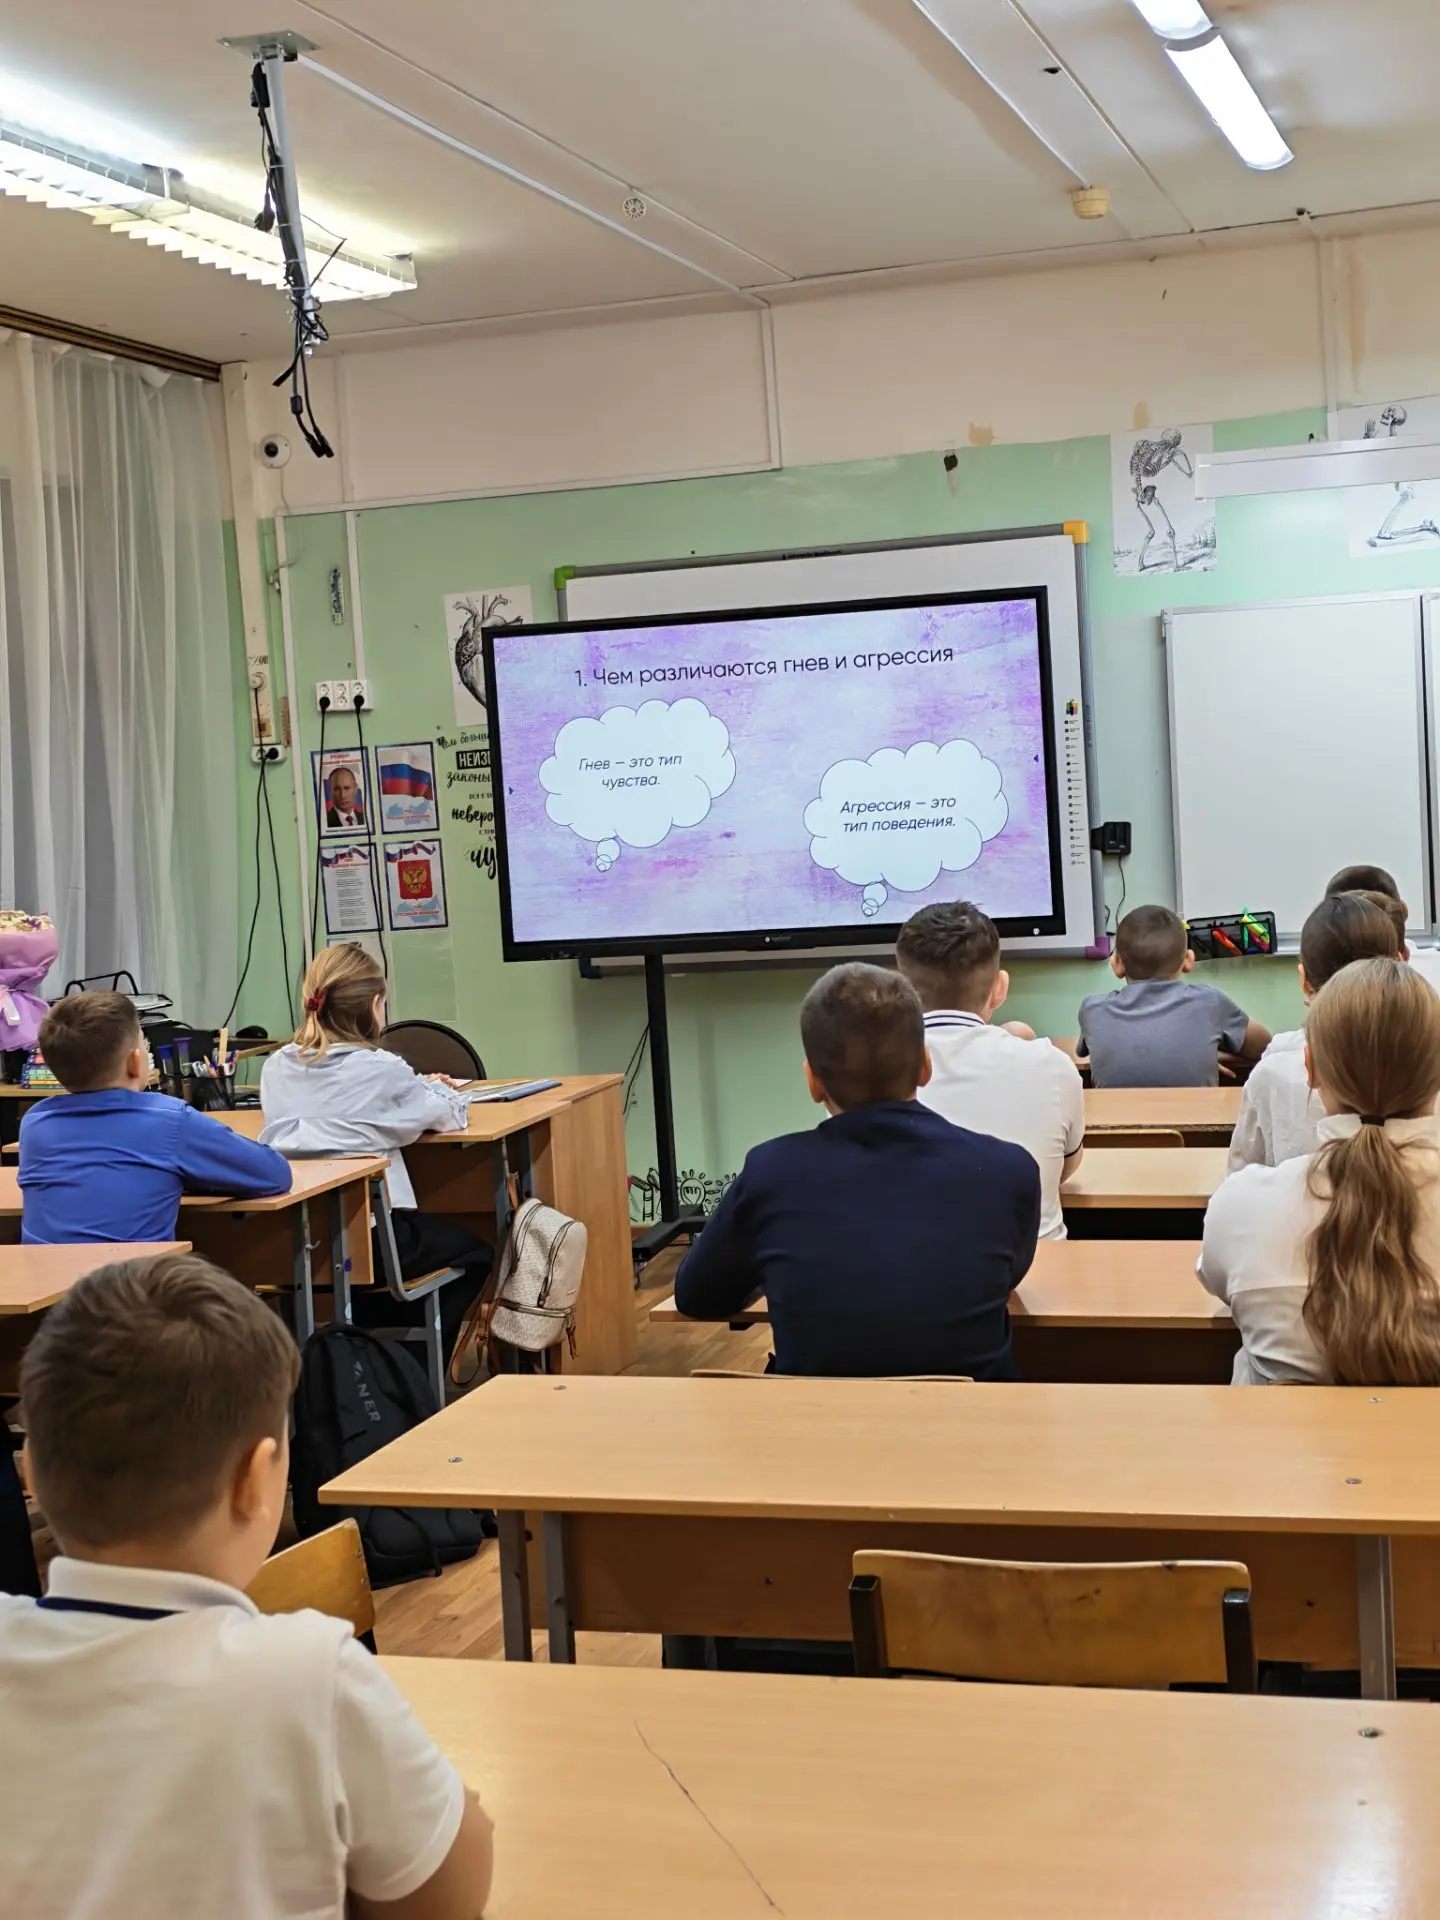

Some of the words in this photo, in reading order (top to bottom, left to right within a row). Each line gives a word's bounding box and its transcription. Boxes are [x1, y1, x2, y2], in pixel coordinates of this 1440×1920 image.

[574, 669, 588, 687] 1.
[593, 666, 633, 685] Чем
[639, 660, 777, 687] различаются
[784, 657, 829, 672] гнев
[835, 656, 847, 669] и
[853, 648, 953, 671] агрессия
[458, 751, 491, 767] НЕИЗ
[578, 758, 610, 771] Гнев
[629, 757, 654, 768] это
[658, 755, 682, 766] тип
[601, 775, 661, 791] чувства.
[839, 800, 911, 816] Агрессия
[930, 797, 957, 809] это
[843, 822, 868, 832] тип
[871, 816, 956, 831] поведения.
